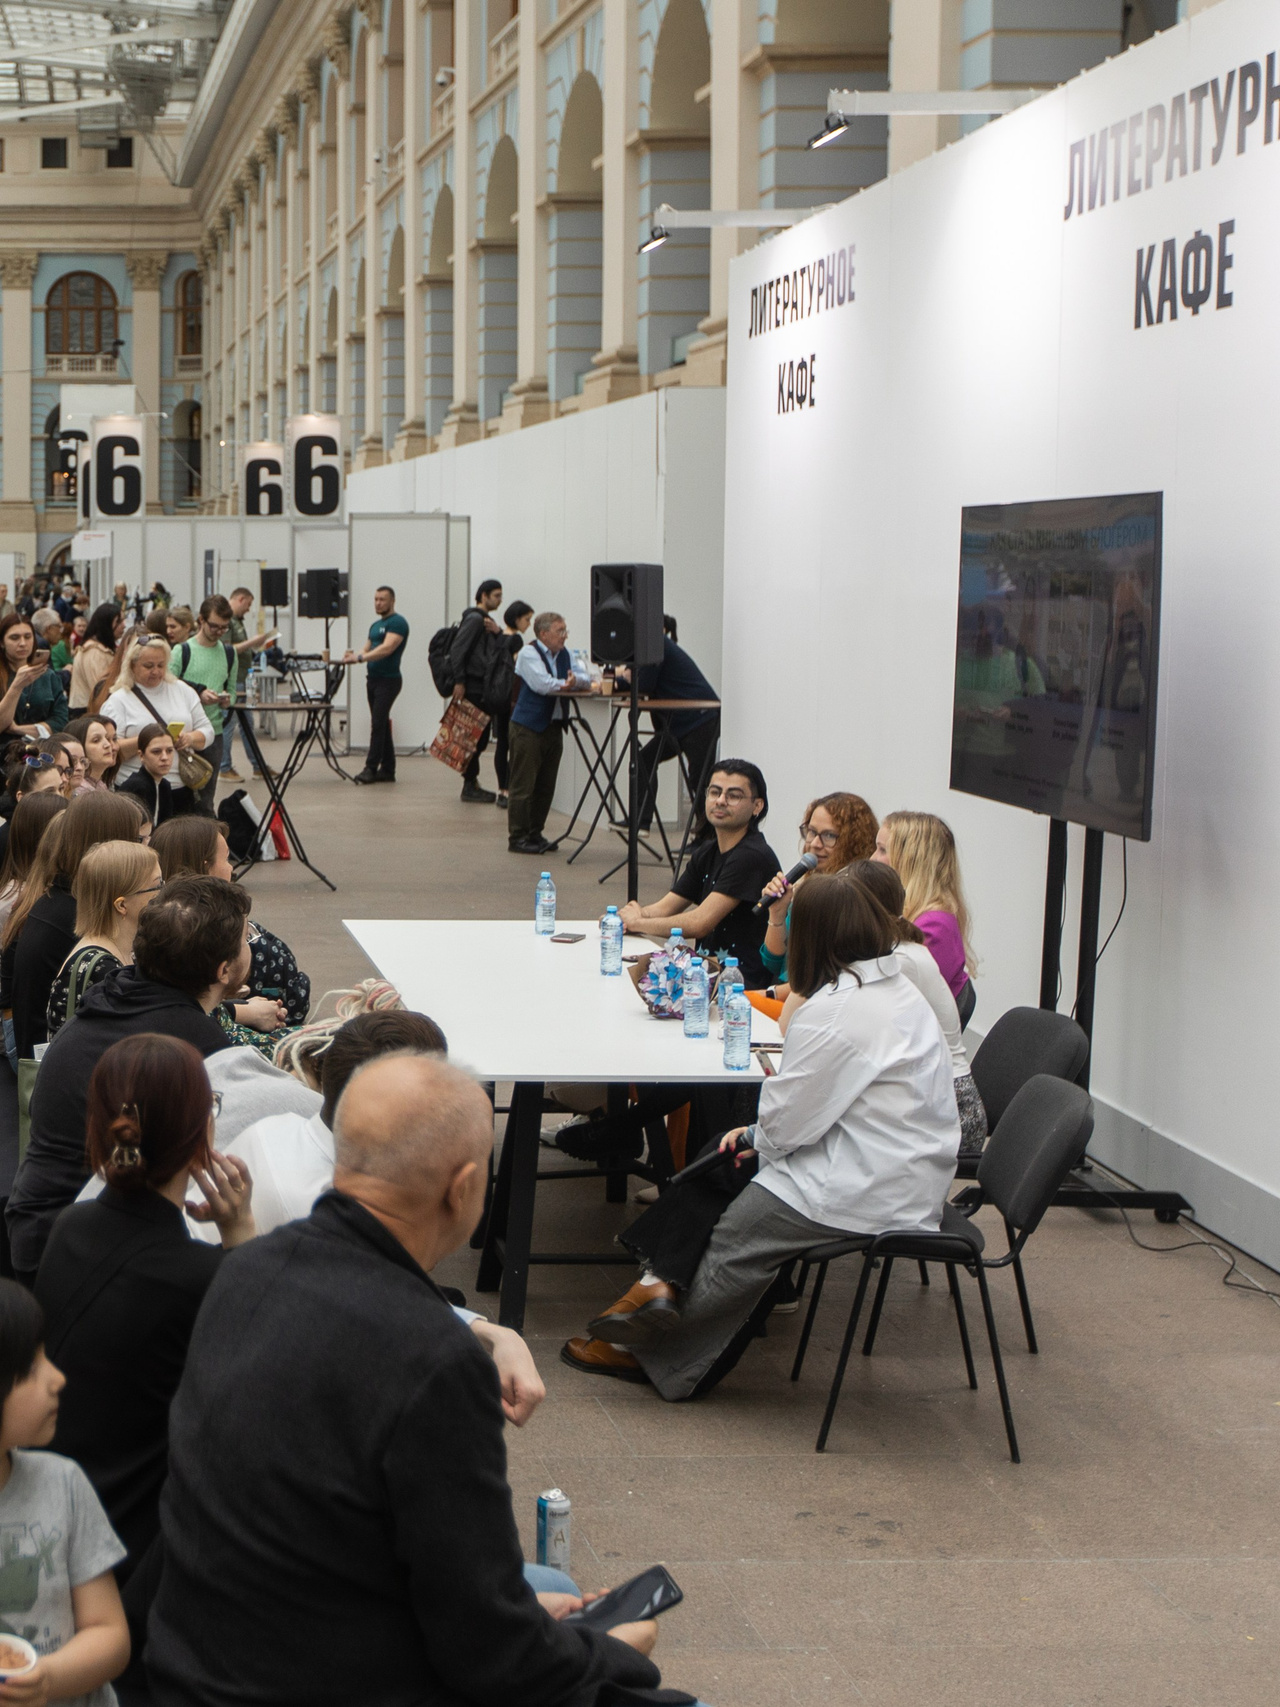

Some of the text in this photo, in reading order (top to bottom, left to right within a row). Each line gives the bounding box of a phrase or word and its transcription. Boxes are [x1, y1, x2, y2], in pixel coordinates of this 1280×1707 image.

[749, 244, 856, 339] ЛИТЕРАТУРНОЕ
[1134, 218, 1235, 330] КАФЕ
[777, 353, 816, 415] КАФЕ
[96, 435, 141, 516] 6
[245, 458, 283, 516] 6
[294, 435, 340, 516] 6
